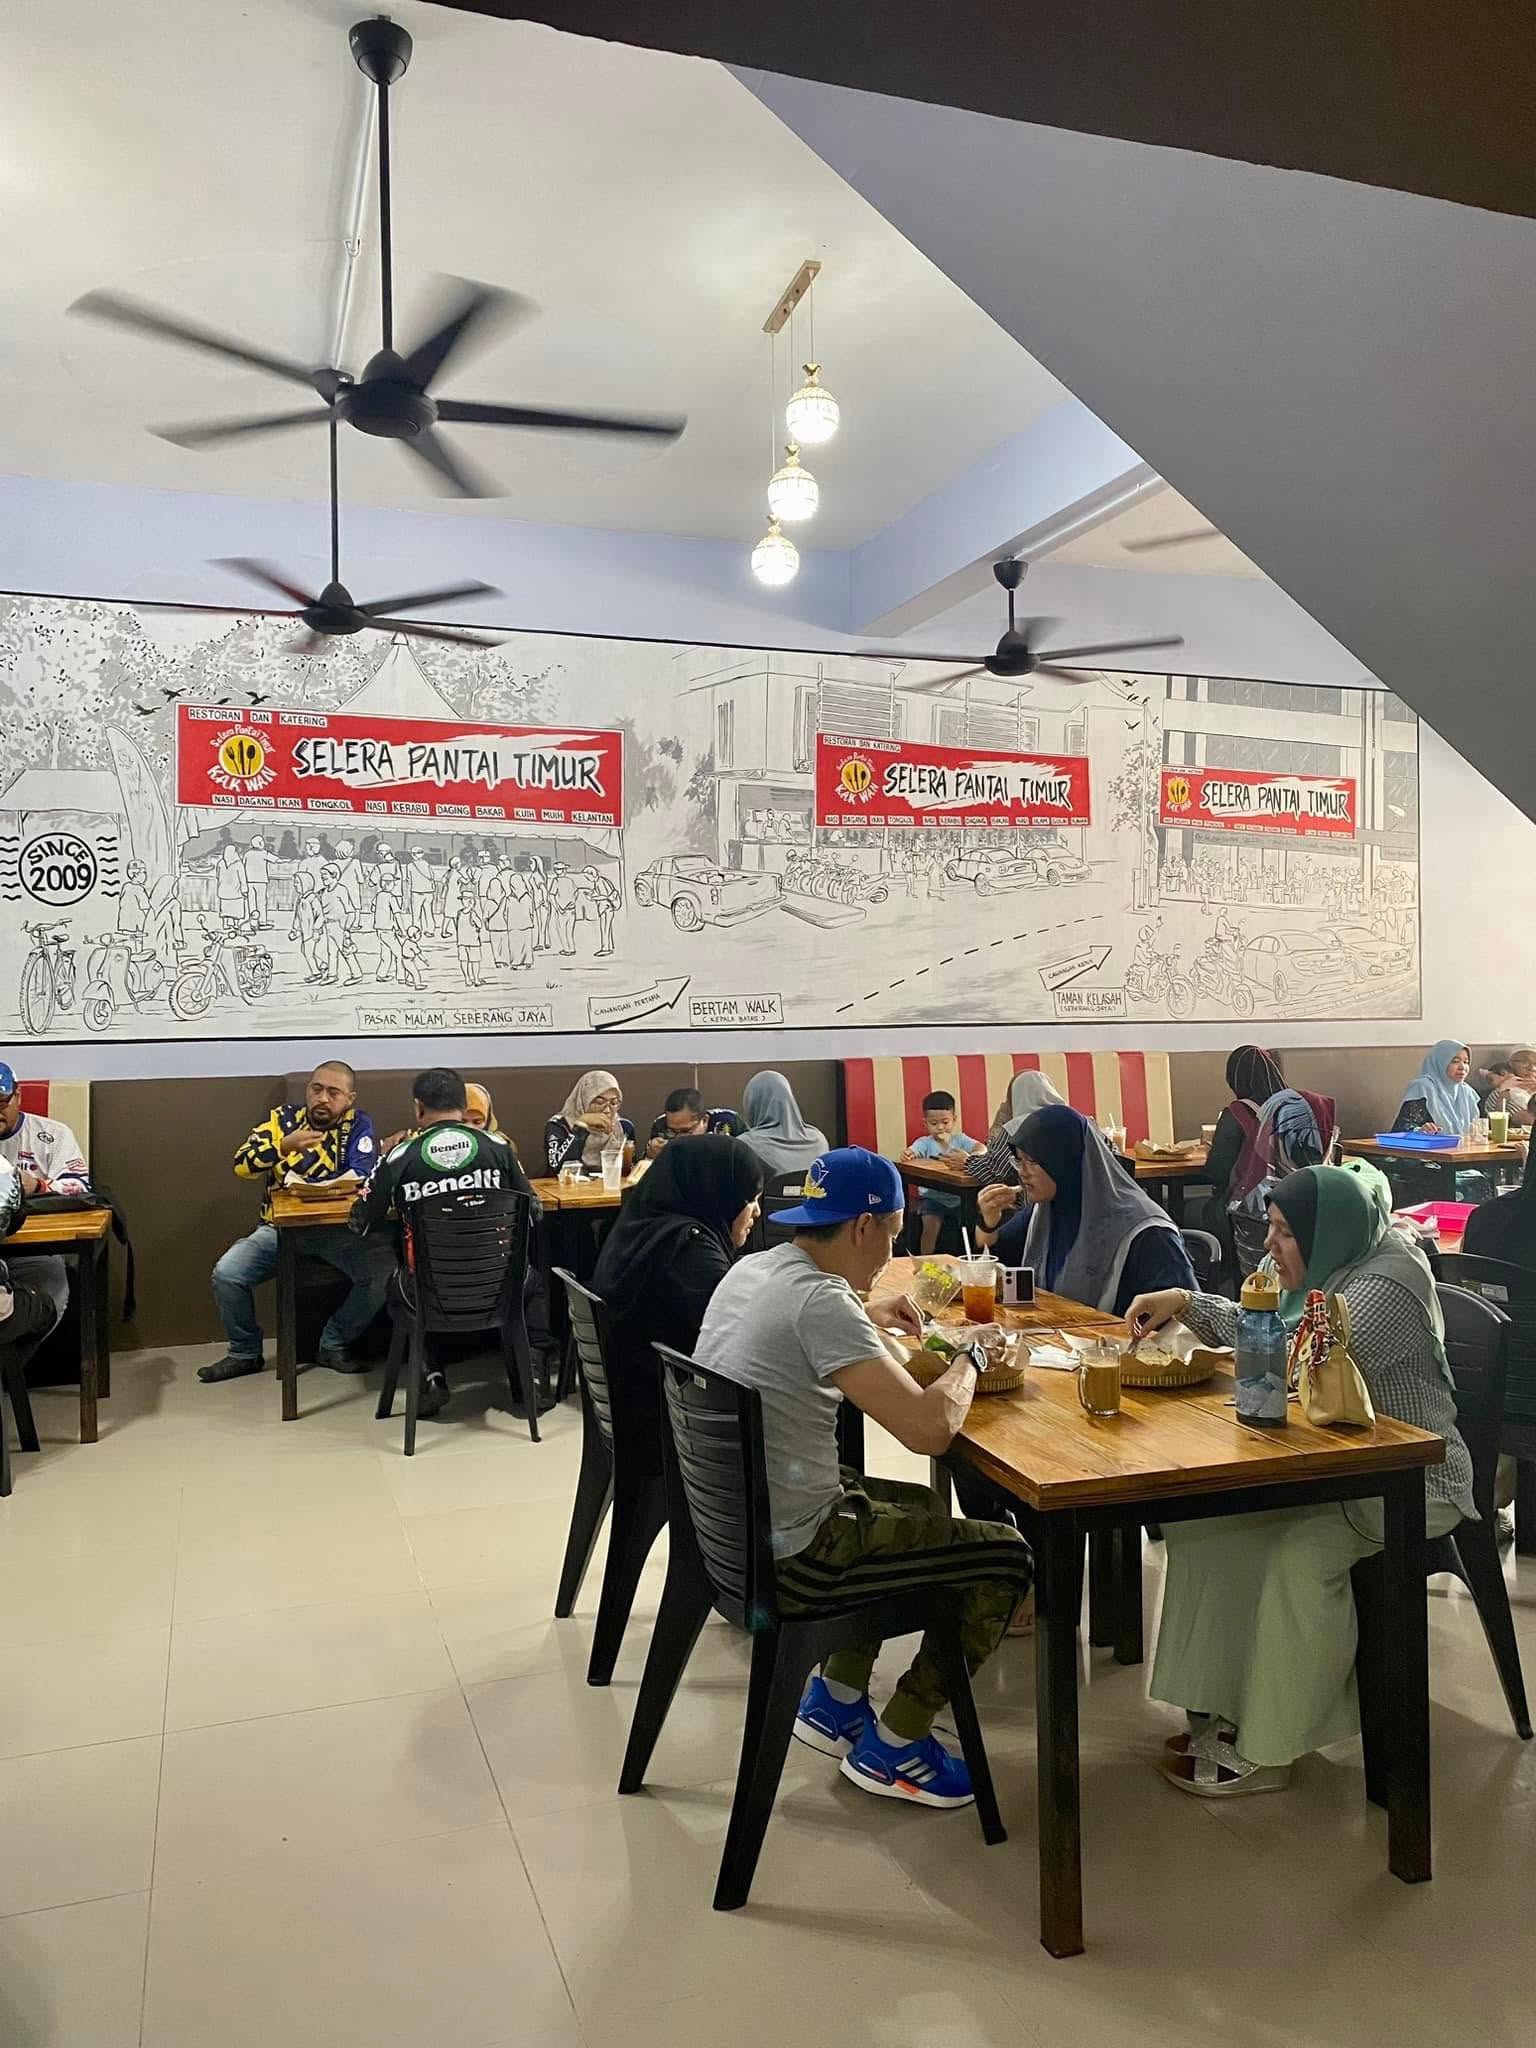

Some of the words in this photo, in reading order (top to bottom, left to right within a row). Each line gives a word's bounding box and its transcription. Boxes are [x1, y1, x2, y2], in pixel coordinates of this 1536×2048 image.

[189, 709, 241, 721] RESTORAN
[252, 712, 270, 723] DAN
[280, 714, 325, 726] KATERING
[824, 736, 856, 746] RESTORAN
[207, 764, 241, 792] KAK
[244, 766, 278, 792] WAN
[294, 740, 395, 780] SELERA
[408, 745, 498, 785] PANTAI
[513, 753, 602, 794] TIMUR
[835, 783, 856, 805] KAK
[859, 782, 880, 804] WAN
[885, 766, 947, 798] SELERA
[955, 772, 1008, 801] PANTAI
[1020, 778, 1072, 809] TIMUR
[214, 795, 233, 805] NASI
[239, 797, 274, 807] DAGANG
[279, 799, 301, 808] IKAN
[310, 800, 351, 810] TONGKOL
[367, 802, 386, 812] NASI
[393, 803, 428, 814] KERABU
[438, 806, 469, 816] DAGING
[477, 807, 504, 817] BAKAR
[515, 809, 535, 819] KUIH
[543, 811, 563, 820] MUIH
[572, 812, 613, 823] KELANTAN
[1202, 783, 1251, 810] SELERA
[1258, 786, 1300, 815] PANTAI
[1307, 790, 1349, 820] TIMUR
[27, 839, 89, 866] SINCE
[30, 863, 92, 892] 2009
[634, 993, 661, 1007] PERTAMA
[692, 1001, 738, 1016] BERTAM
[745, 1000, 777, 1013] WALK
[1056, 992, 1083, 1004] TAMAN
[1086, 992, 1122, 1005] KELASAH
[364, 1014, 397, 1026] PASAR
[405, 1013, 443, 1026] MALAM
[453, 1011, 512, 1025] SEBERANG
[518, 1011, 547, 1023] JAYA
[430, 1141, 470, 1154] Benelli
[402, 1168, 501, 1202] Benelli
